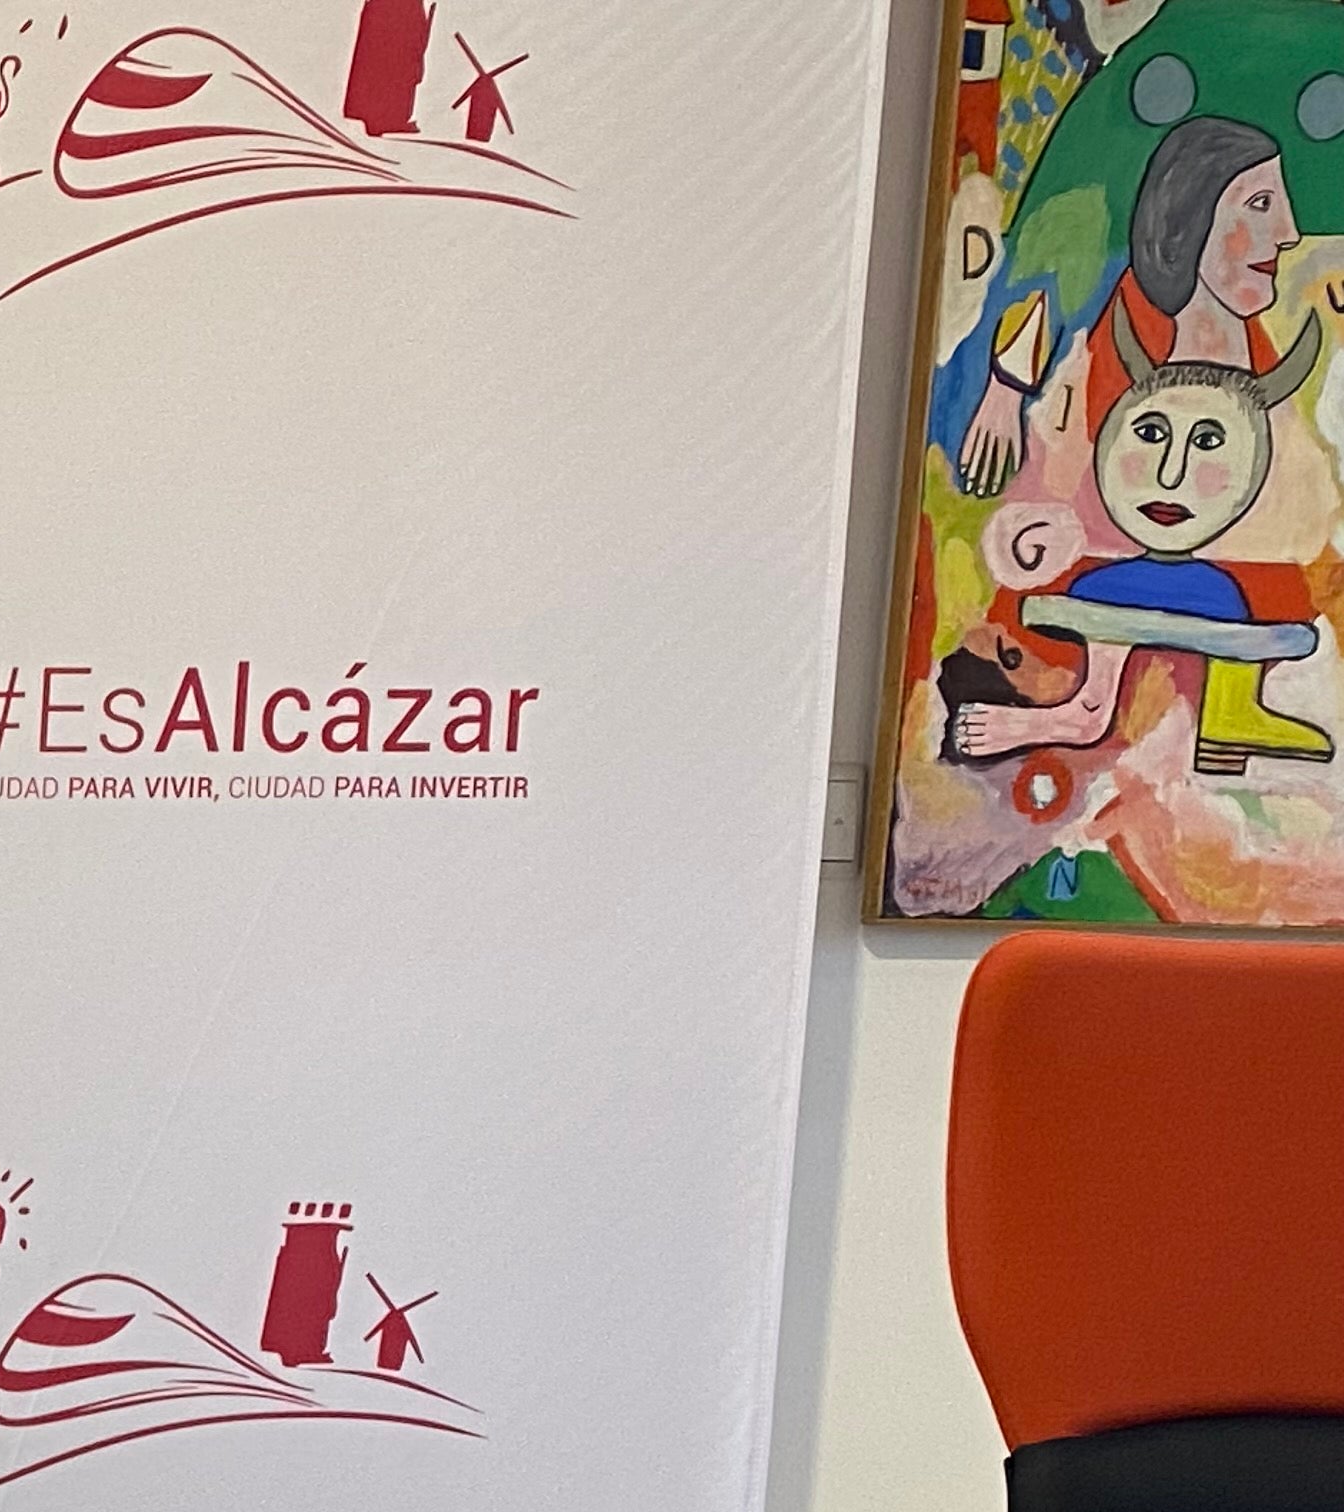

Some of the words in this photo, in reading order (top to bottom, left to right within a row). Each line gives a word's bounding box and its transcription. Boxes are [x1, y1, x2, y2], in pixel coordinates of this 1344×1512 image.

[68, 777, 135, 798] PARA
[145, 777, 220, 803] VIVIR,
[228, 777, 325, 799] CIUDAD
[334, 777, 400, 798] PARA
[410, 776, 528, 798] INVERTIR
